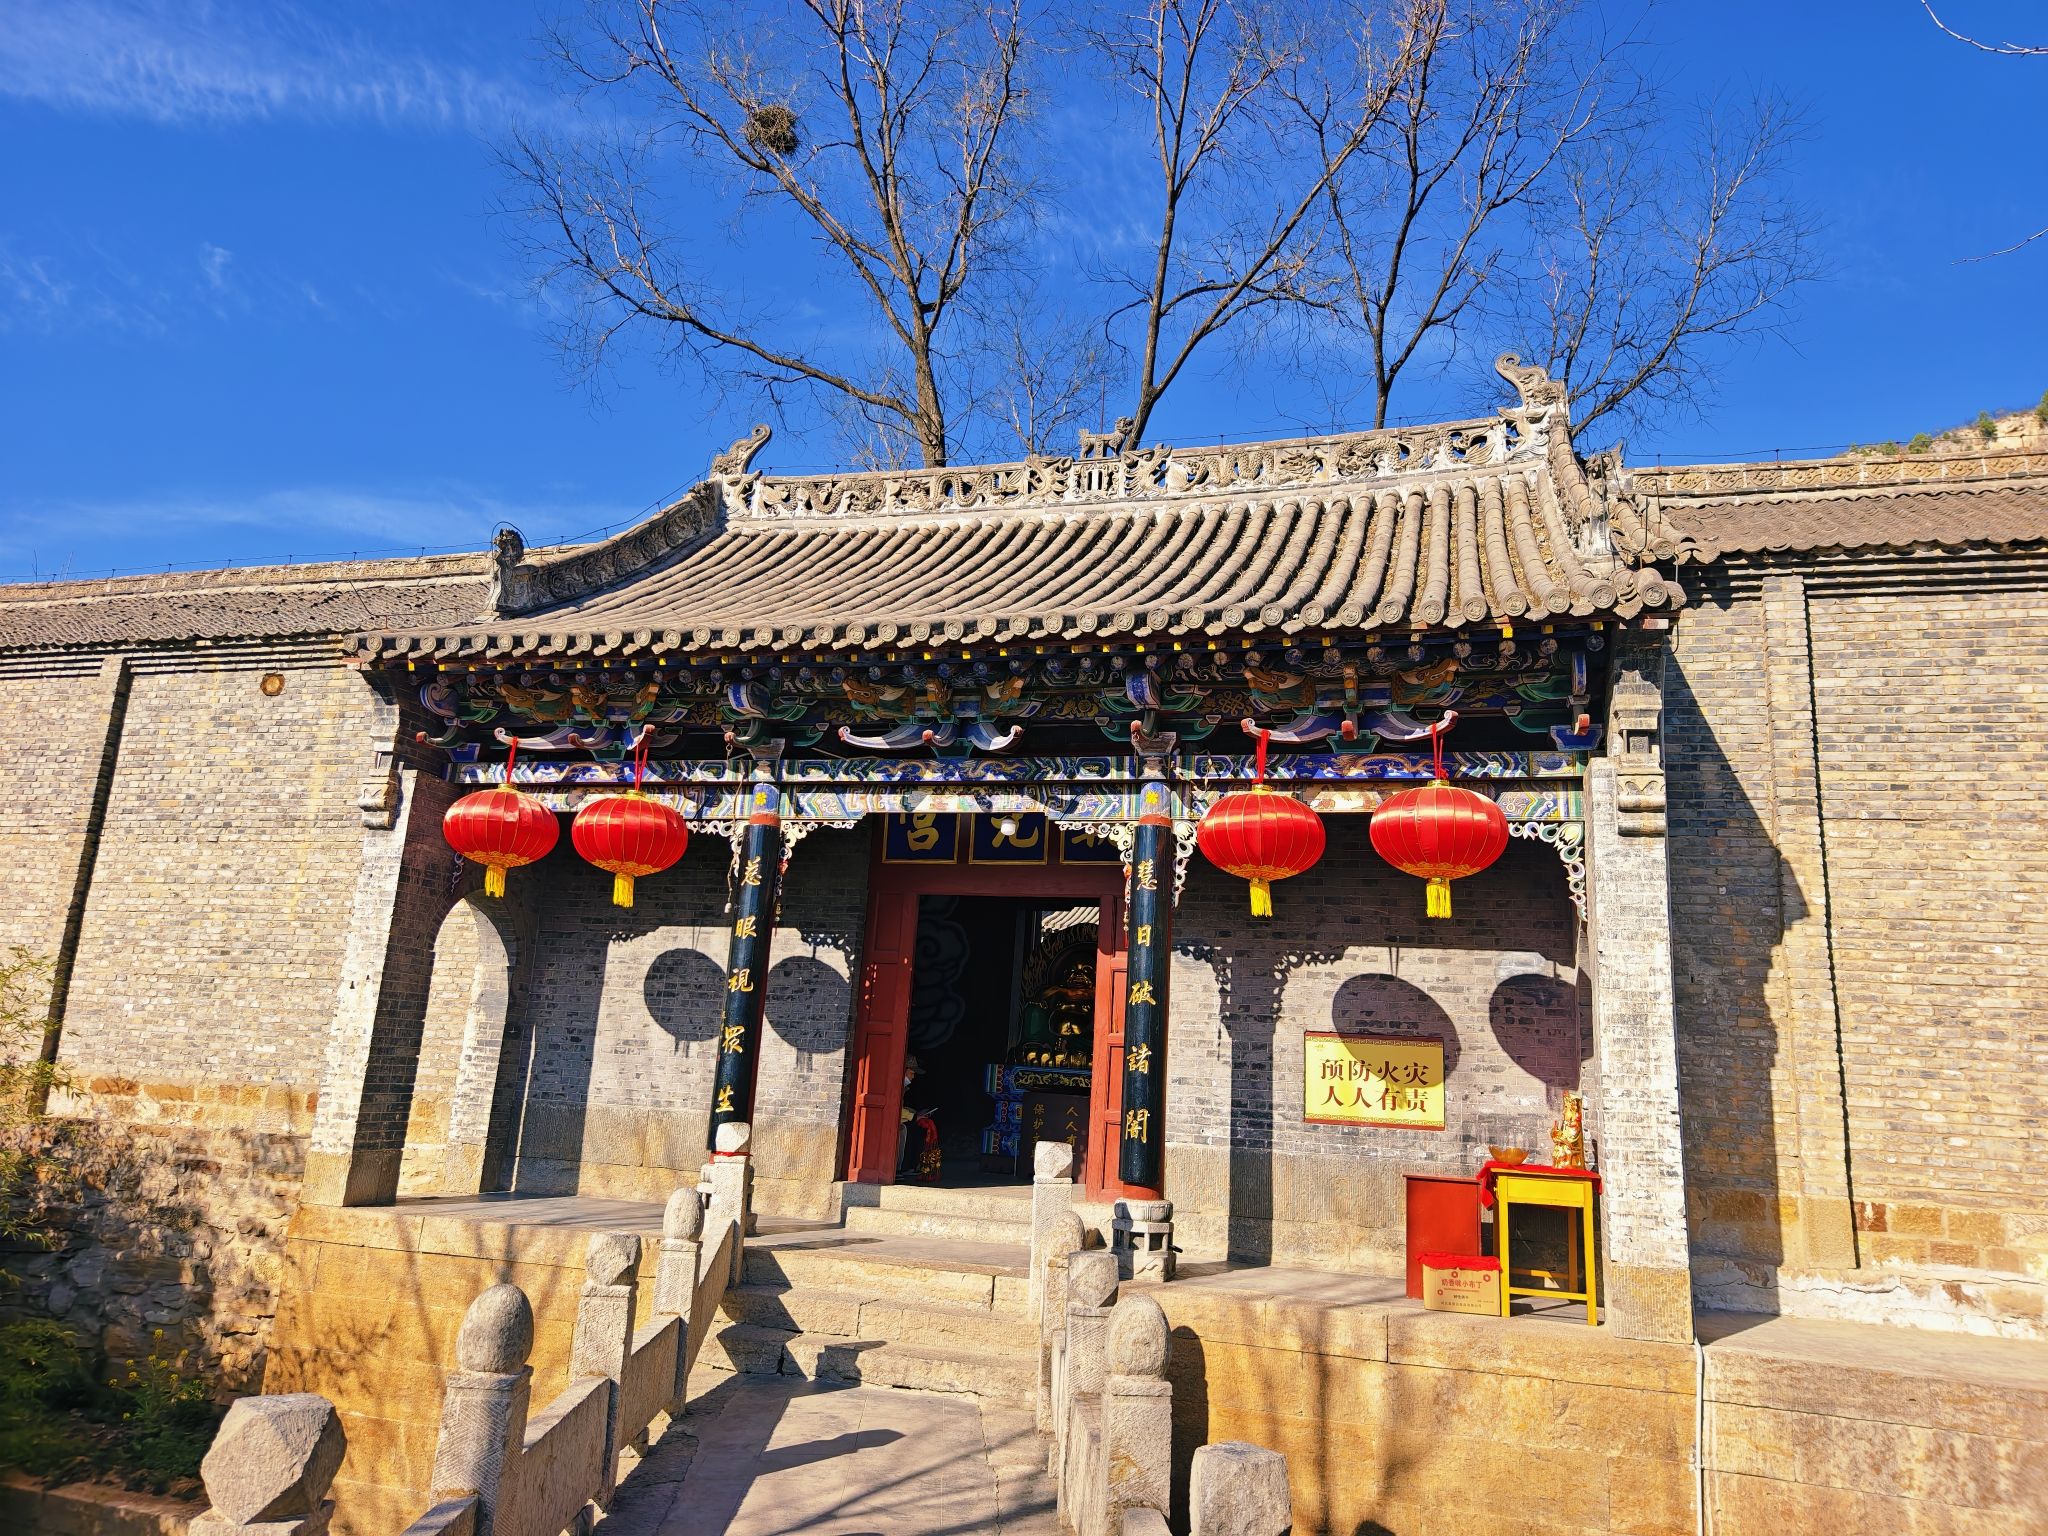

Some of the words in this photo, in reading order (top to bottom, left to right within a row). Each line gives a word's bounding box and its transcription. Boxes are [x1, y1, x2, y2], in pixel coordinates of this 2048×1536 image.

[1320, 1058, 1430, 1085] 预防火灾
[1321, 1086, 1429, 1112] 人人有责
